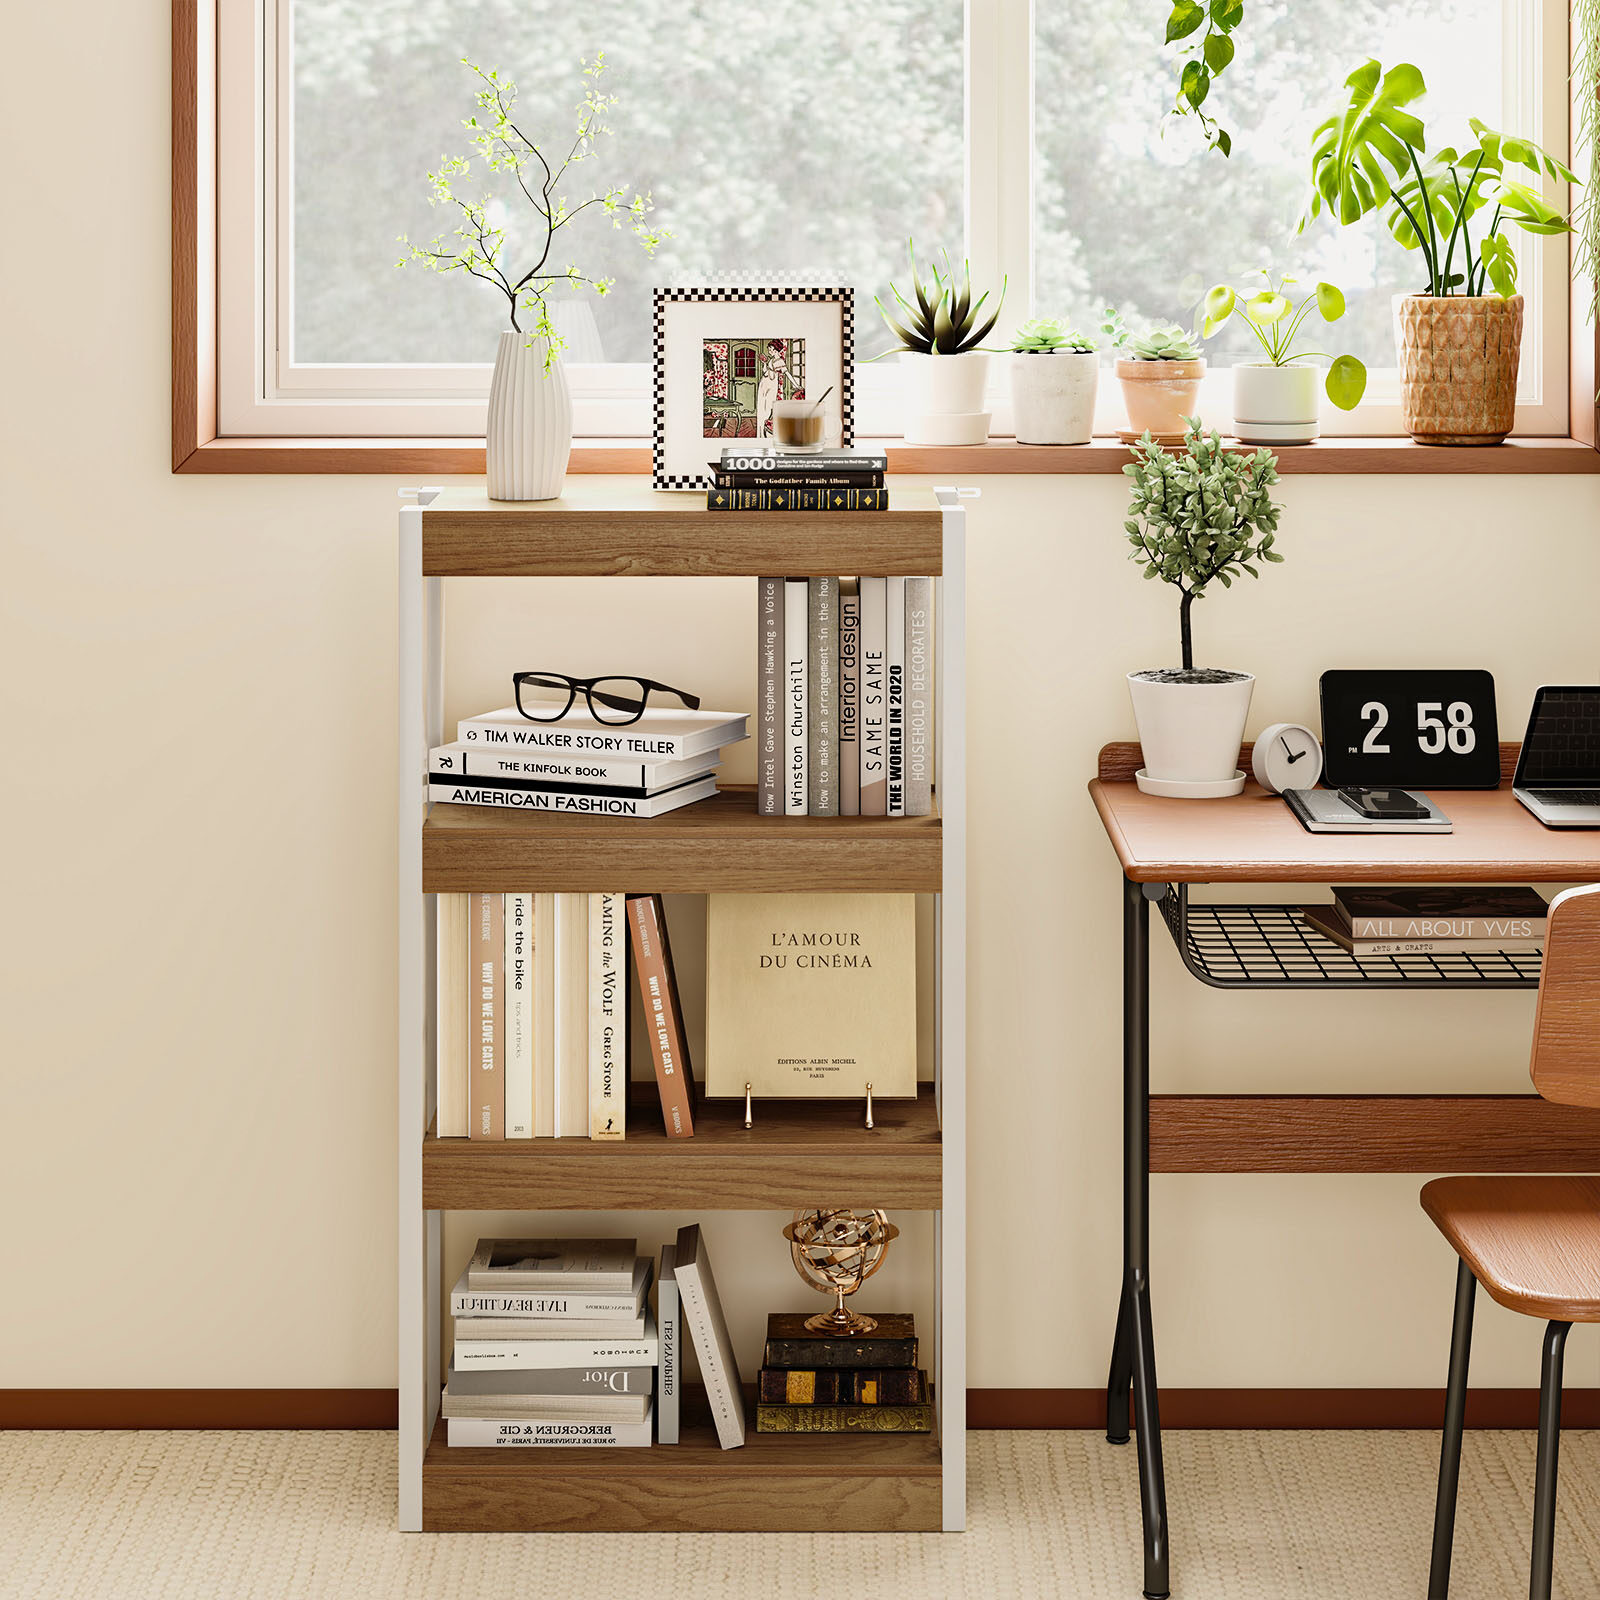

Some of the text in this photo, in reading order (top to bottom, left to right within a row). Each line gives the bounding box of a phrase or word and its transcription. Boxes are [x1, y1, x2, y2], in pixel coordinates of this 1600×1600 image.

[727, 458, 775, 470] 1000
[765, 584, 774, 613] Voice
[819, 603, 828, 621] the
[819, 628, 828, 640] in
[765, 632, 776, 674] Hawking
[820, 647, 830, 715] arrangement
[840, 604, 858, 742] Interior design
[766, 680, 776, 722] Stephen
[912, 610, 924, 781] HOUSEHOLD DECORATES
[866, 651, 881, 770] SAME SAME
[766, 728, 774, 752] Gave
[791, 659, 802, 806] Winston Churchill
[821, 722, 828, 733] an
[890, 665, 901, 811] THE WORLD IN 2020
[1361, 701, 1390, 753] 2
[1417, 701, 1476, 754] 58
[485, 730, 674, 754] TIM WALKER STORY TELLER
[819, 740, 828, 765] make
[439, 756, 452, 769] R
[498, 762, 607, 778] THE KINFOLK BOOK
[765, 759, 774, 788] Intel
[820, 772, 828, 783] to
[452, 789, 636, 814] AMERICAN FASHION
[766, 794, 774, 813] How
[819, 790, 828, 808] How
[482, 906, 491, 941] CORLEONE
[1363, 921, 1399, 936] ALL
[1406, 921, 1474, 936] ABOUT
[1484, 921, 1531, 936] YVES
[515, 898, 524, 990] ride the bike
[640, 925, 651, 958] CORLEONE
[772, 933, 861, 946] L'AMOUR
[602, 893, 616, 1016] AMING the WOLF
[760, 954, 872, 968] DU CINÉMA
[482, 962, 493, 1070] WHY DO WE LOVE CATS
[648, 976, 674, 1075] WHY DO WE LOVE CATS
[603, 1027, 613, 1098] GREG STONE
[482, 1113, 490, 1135] BOOKS
[673, 1112, 682, 1134] BOOKS
[582, 1372, 630, 1392] Dior
